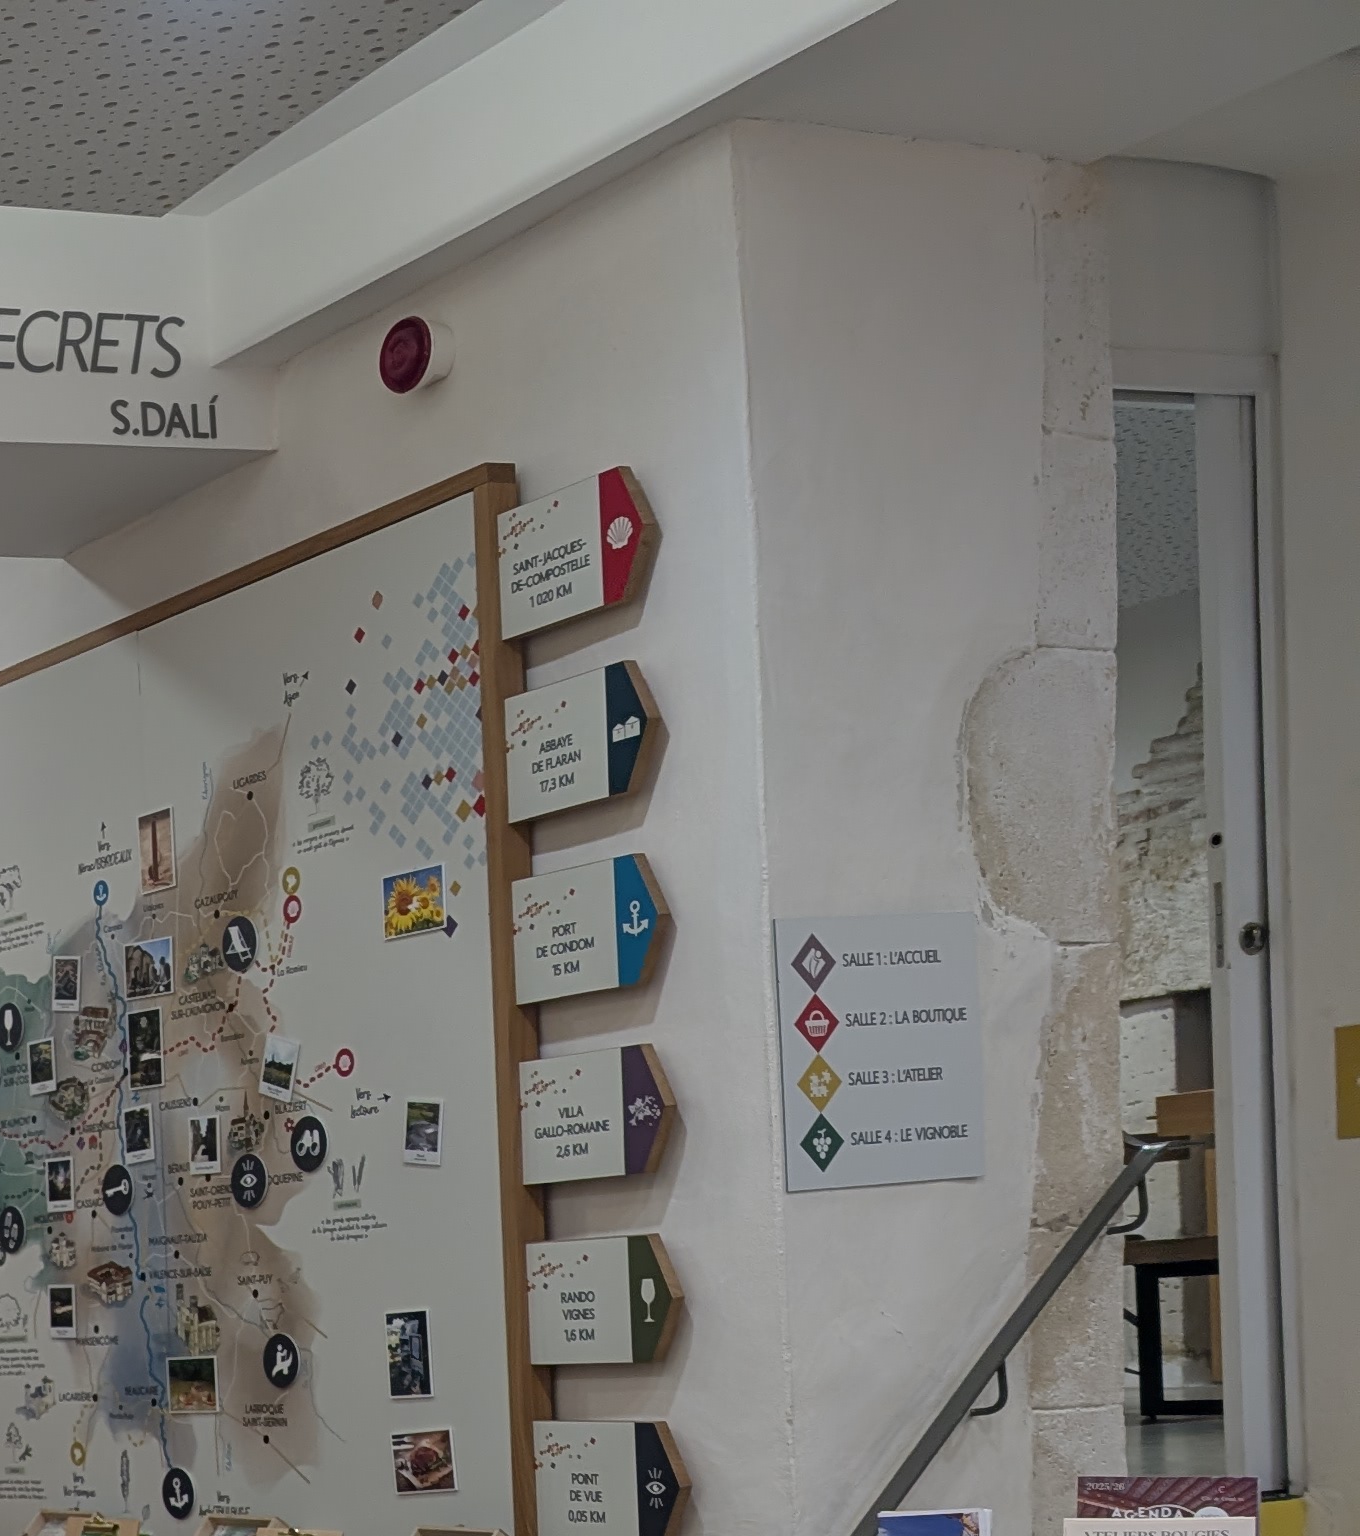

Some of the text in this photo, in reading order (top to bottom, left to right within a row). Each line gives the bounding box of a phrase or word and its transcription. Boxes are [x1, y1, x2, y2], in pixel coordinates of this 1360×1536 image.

[111, 396, 219, 440] S.DALÍ
[512, 539, 587, 576] SAINT-JACQUES-
[510, 553, 591, 595] DE-COMPOSTELLE
[555, 582, 572, 600] KM
[539, 734, 573, 755] ABBAYE
[531, 749, 582, 775] DE FLARAN
[539, 772, 575, 794] 17,3 KM
[551, 920, 577, 938] PORT
[536, 935, 595, 959] DE CONDOM
[841, 947, 942, 968] SALLE L'ACCUEIL
[551, 959, 580, 977] 15 KM
[845, 1006, 968, 1027] SALLE LA BOUTIQUE
[848, 1070, 879, 1086] SALLE
[897, 1066, 944, 1084] L'ATELIER
[558, 1105, 584, 1119] VILLA
[534, 1119, 611, 1141] GALLO-ROMAINE
[850, 1130, 882, 1146] SALLE
[899, 1127, 913, 1143] LE
[915, 1123, 969, 1141] VIGNOBLE
[555, 1142, 589, 1158] 2,6 KM
[560, 1290, 596, 1306] RANDO
[562, 1306, 596, 1322] VIGNES
[578, 1327, 595, 1342] KM
[571, 1472, 599, 1487] POINT
[569, 1488, 603, 1504] DE VUE
[568, 1509, 607, 1525] 0,05 KM
